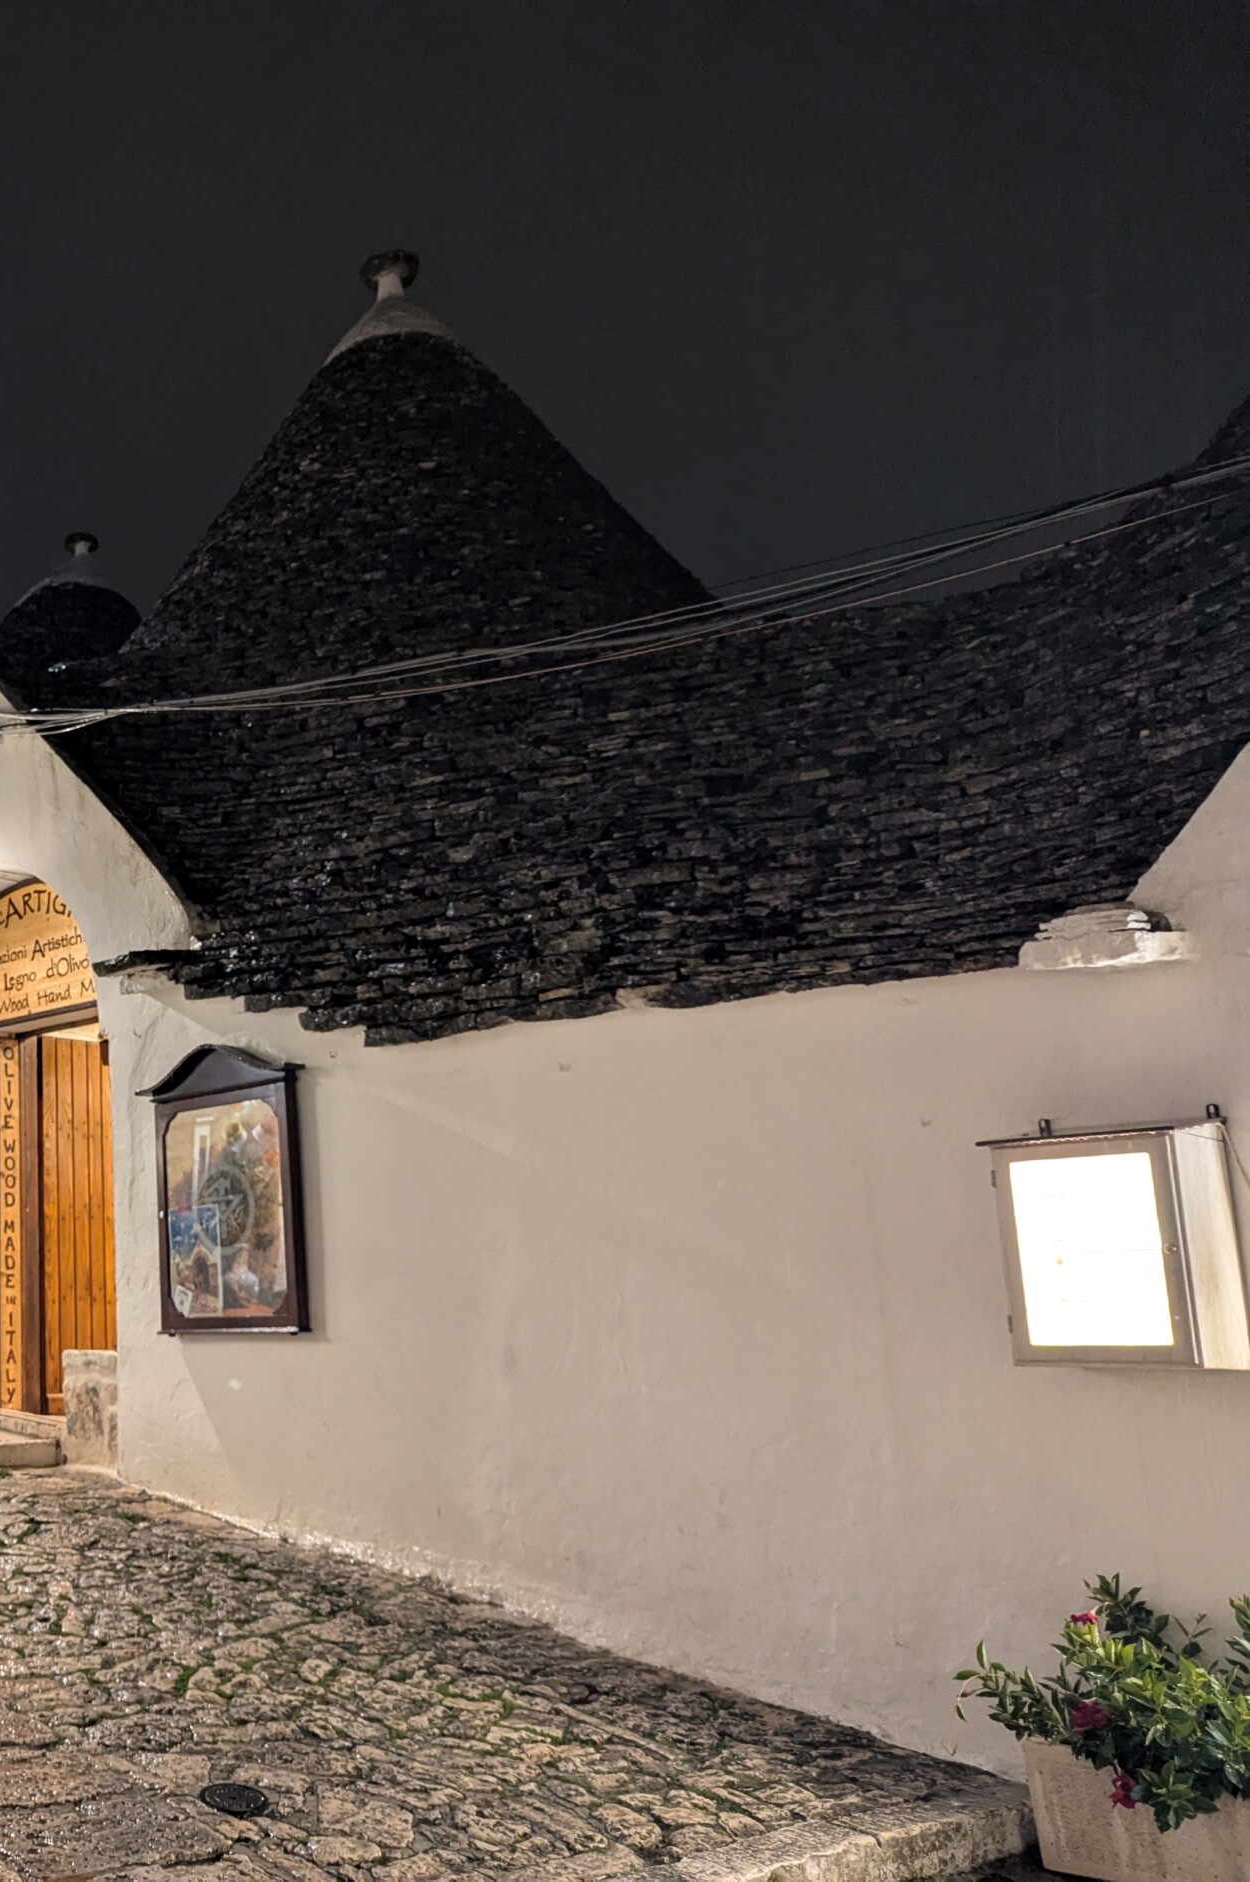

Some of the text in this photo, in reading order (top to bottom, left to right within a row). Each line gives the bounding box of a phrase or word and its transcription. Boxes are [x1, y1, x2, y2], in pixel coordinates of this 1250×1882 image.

[3, 971, 37, 992] Legno
[46, 953, 90, 978] d'Olivo
[37, 984, 71, 1006] Hand
[3, 1047, 15, 1129] OLIVE
[4, 1139, 16, 1207] WOOD
[4, 1220, 16, 1289] MADE
[6, 1311, 17, 1404] ITALY
